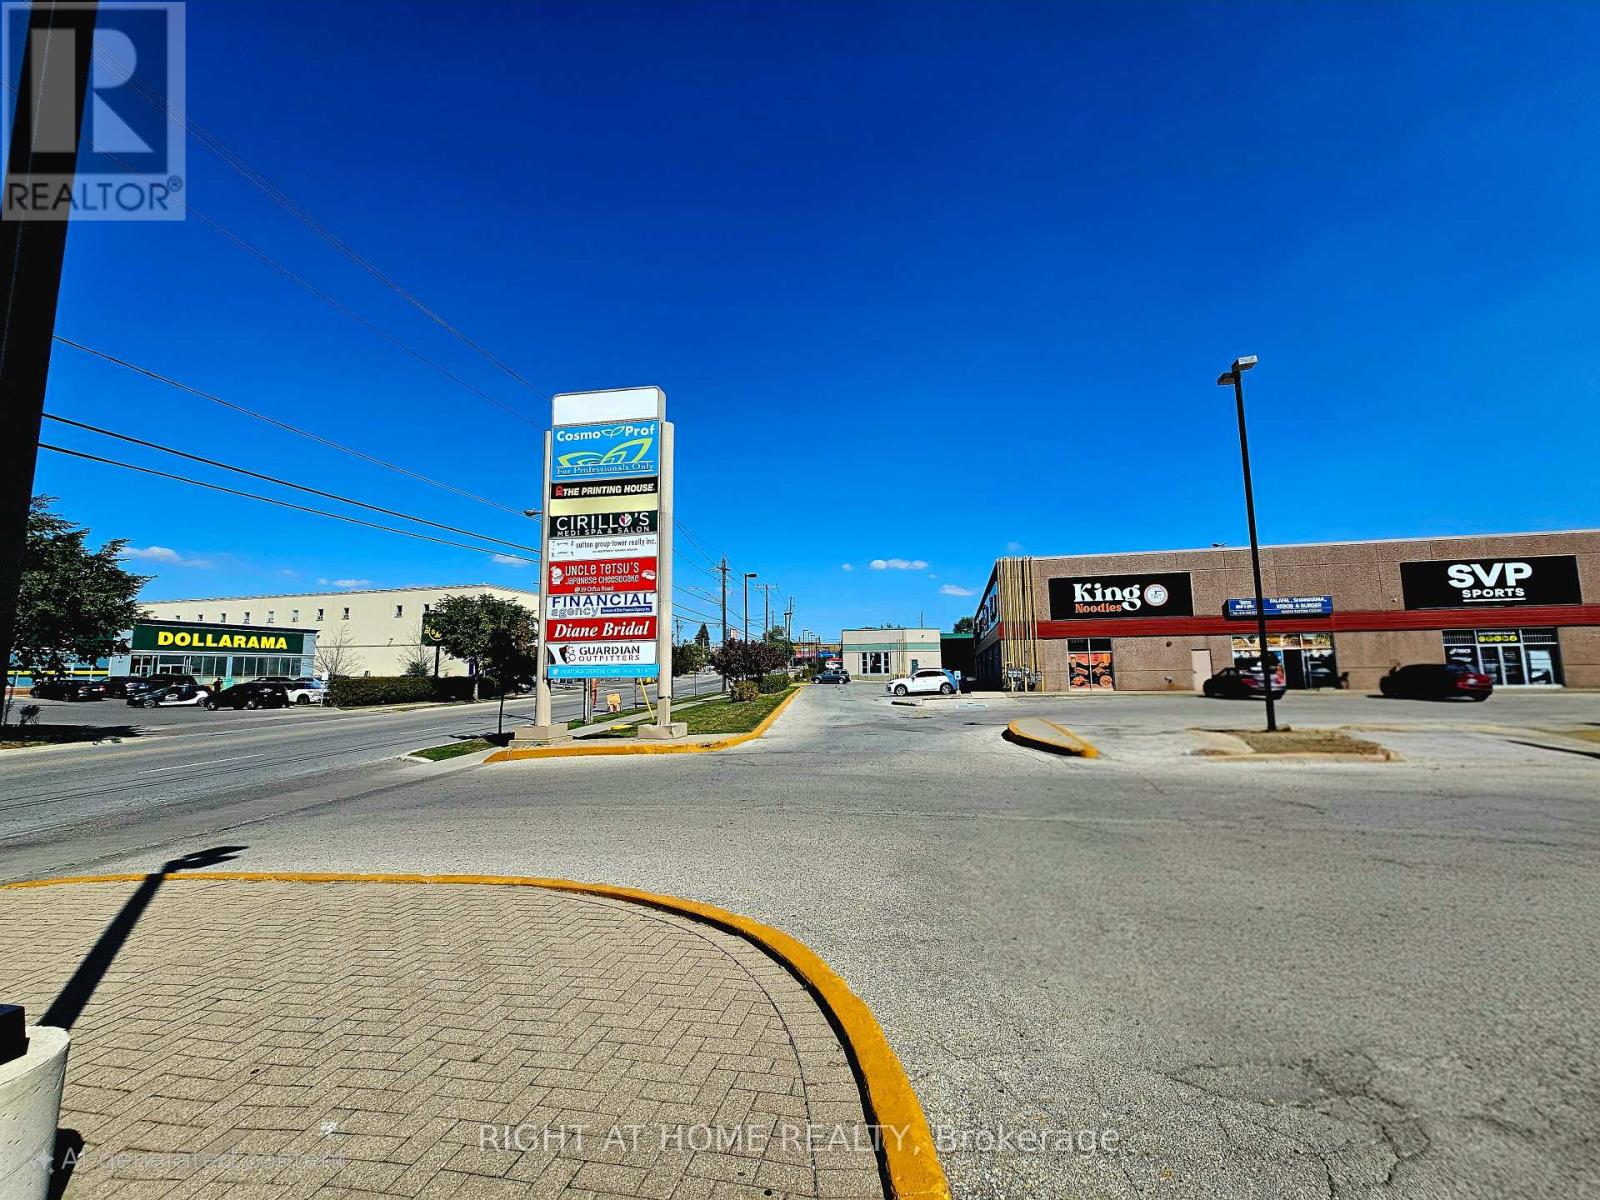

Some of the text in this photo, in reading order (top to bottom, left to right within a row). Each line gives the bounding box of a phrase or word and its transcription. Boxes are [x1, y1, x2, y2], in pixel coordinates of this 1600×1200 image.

[556, 424, 655, 442] Cosmo Prof
[556, 462, 654, 475] For Professionals Only
[562, 483, 654, 497] THE PRINTING HOUSE
[556, 512, 650, 531] CIRILLO'S
[557, 526, 650, 537] MEDI SPA & SALON
[1447, 562, 1532, 588] SVP
[1072, 582, 1142, 611] King
[1462, 587, 1525, 598] SPORTS
[552, 593, 653, 609] FINANCIAL
[1074, 602, 1122, 613] Noodles
[551, 606, 599, 618] agency
[554, 620, 650, 638] Diane Bridal
[157, 631, 288, 650] DOLLARAMA
[579, 645, 640, 655] GUARDIAN
